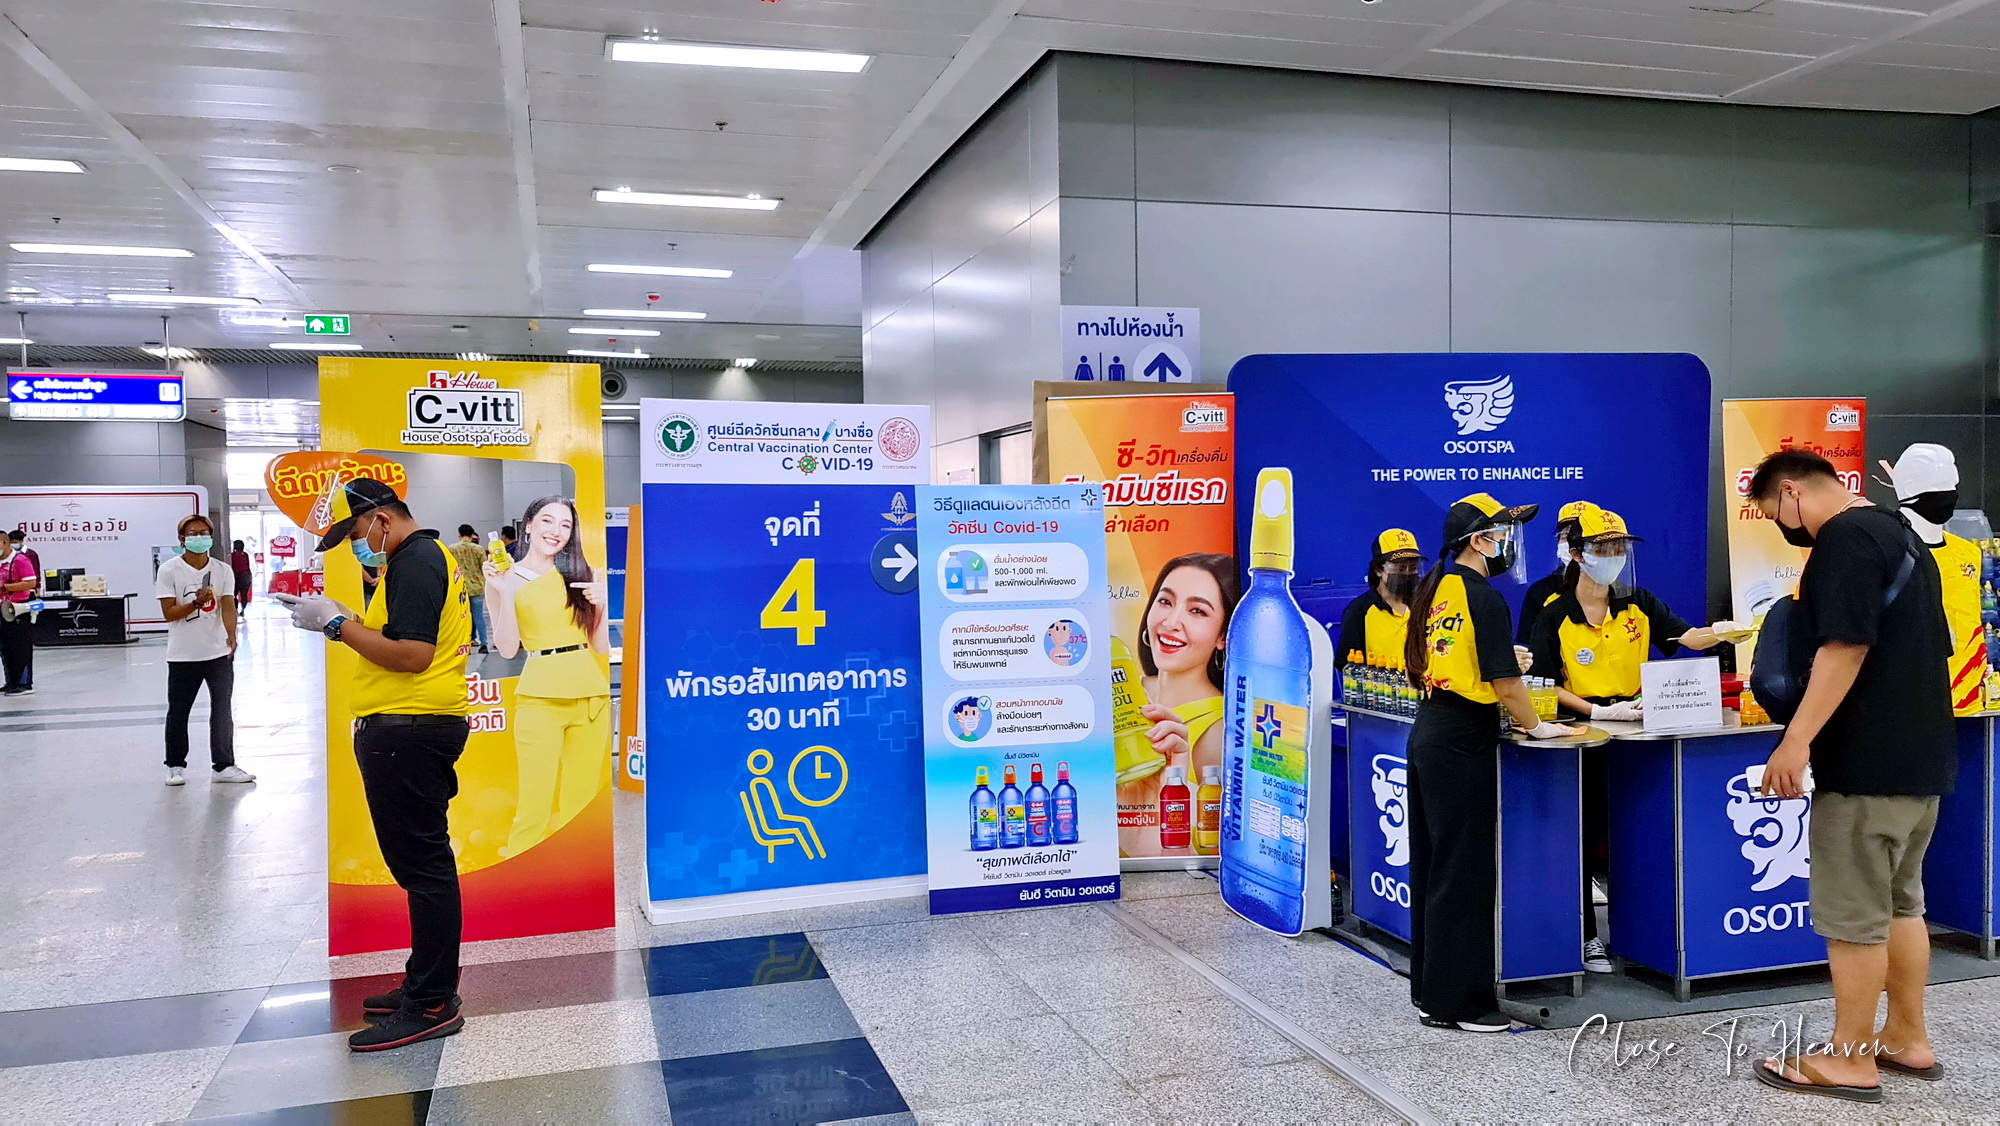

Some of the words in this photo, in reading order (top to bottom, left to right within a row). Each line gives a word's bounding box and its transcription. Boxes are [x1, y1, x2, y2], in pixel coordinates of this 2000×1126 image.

[1077, 312, 1184, 338] ทางไปห้องน้ำ
[449, 372, 495, 389] House
[415, 394, 515, 424] C-vitt
[1185, 410, 1224, 423] C-vitt
[1829, 412, 1858, 424] C-vitt
[402, 432, 439, 442] House
[442, 432, 490, 444] Osotspa
[493, 433, 528, 443] Foods
[707, 421, 820, 439] ศูนย์ฉีดวัคซีนกลาง
[835, 421, 873, 438] บางซื่อ
[707, 441, 753, 453] Central
[757, 442, 829, 453] Vaccination
[833, 443, 873, 454] Center
[1117, 439, 1177, 468] ซี-วิท
[1176, 447, 1228, 463] เครื่องดื่ม
[1443, 440, 1515, 454] OSOTSPA
[1371, 468, 1400, 482] THE
[1404, 468, 1456, 481] POWER
[1458, 468, 1479, 480] TO
[1483, 467, 1551, 480] ENHANCE
[1554, 467, 1584, 480] LIFE
[933, 496, 1071, 515] วิธีดูแลตนเองหลังฉีด
[17, 518, 55, 537] ศูนย์
[60, 518, 128, 533] ชะลอวัย
[764, 501, 820, 547] จุดที่
[947, 519, 987, 534] วัคซีน
[993, 520, 1059, 534] Covid-19
[994, 567, 1034, 576] 500-1,000
[760, 558, 826, 645] 4
[665, 667, 907, 698] พักรอสังเกตอาการ
[747, 707, 781, 731] 30
[788, 698, 840, 728] นาที
[1235, 674, 1247, 748] WATER
[1231, 756, 1244, 842] VITAMIN
[976, 849, 1078, 871] “สุขภาพดีเลือกได้”
[1019, 888, 1041, 900] ยันฮี
[1044, 886, 1075, 898] วิตามิน
[1078, 882, 1116, 895] วอเตอร์
[1371, 871, 1411, 908] OSO
[1723, 901, 1814, 935] OSOT
